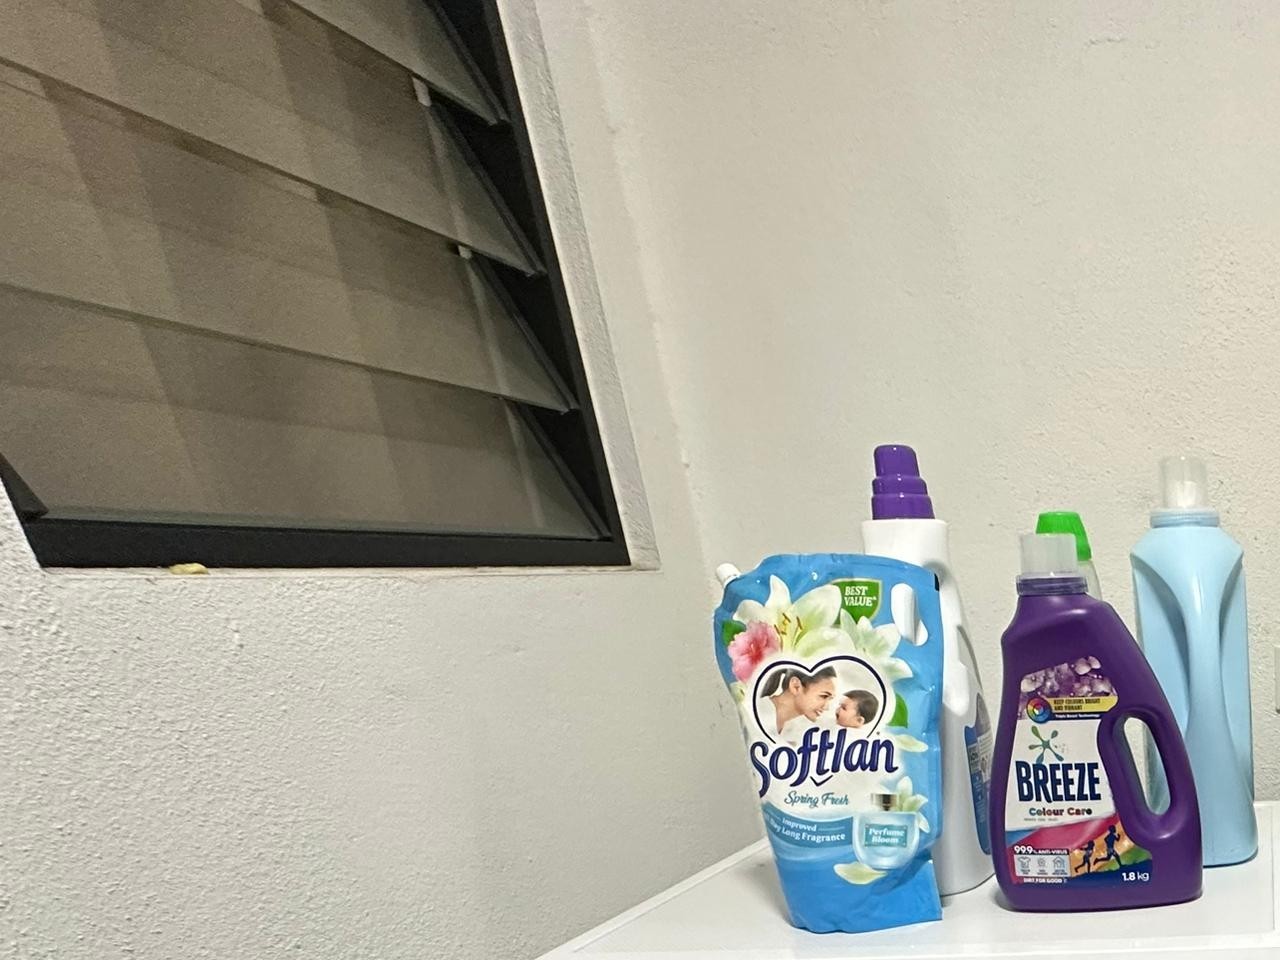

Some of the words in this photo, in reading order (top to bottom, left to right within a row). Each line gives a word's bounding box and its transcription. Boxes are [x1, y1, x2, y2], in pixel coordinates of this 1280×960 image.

[844, 586, 868, 596] BEST
[750, 727, 899, 798] Softlan
[1015, 760, 1102, 803] BREEZE
[783, 790, 819, 808] Spring
[821, 791, 849, 806] Fresh
[1029, 807, 1064, 816] Colour
[1067, 807, 1093, 816] Care
[781, 817, 817, 832] Improved
[781, 825, 801, 840] Long
[801, 832, 846, 843] Fragrance
[868, 827, 905, 836] Perfume
[871, 835, 899, 844] Bloom
[1121, 871, 1136, 882] 1.8
[1137, 871, 1150, 882] kg
